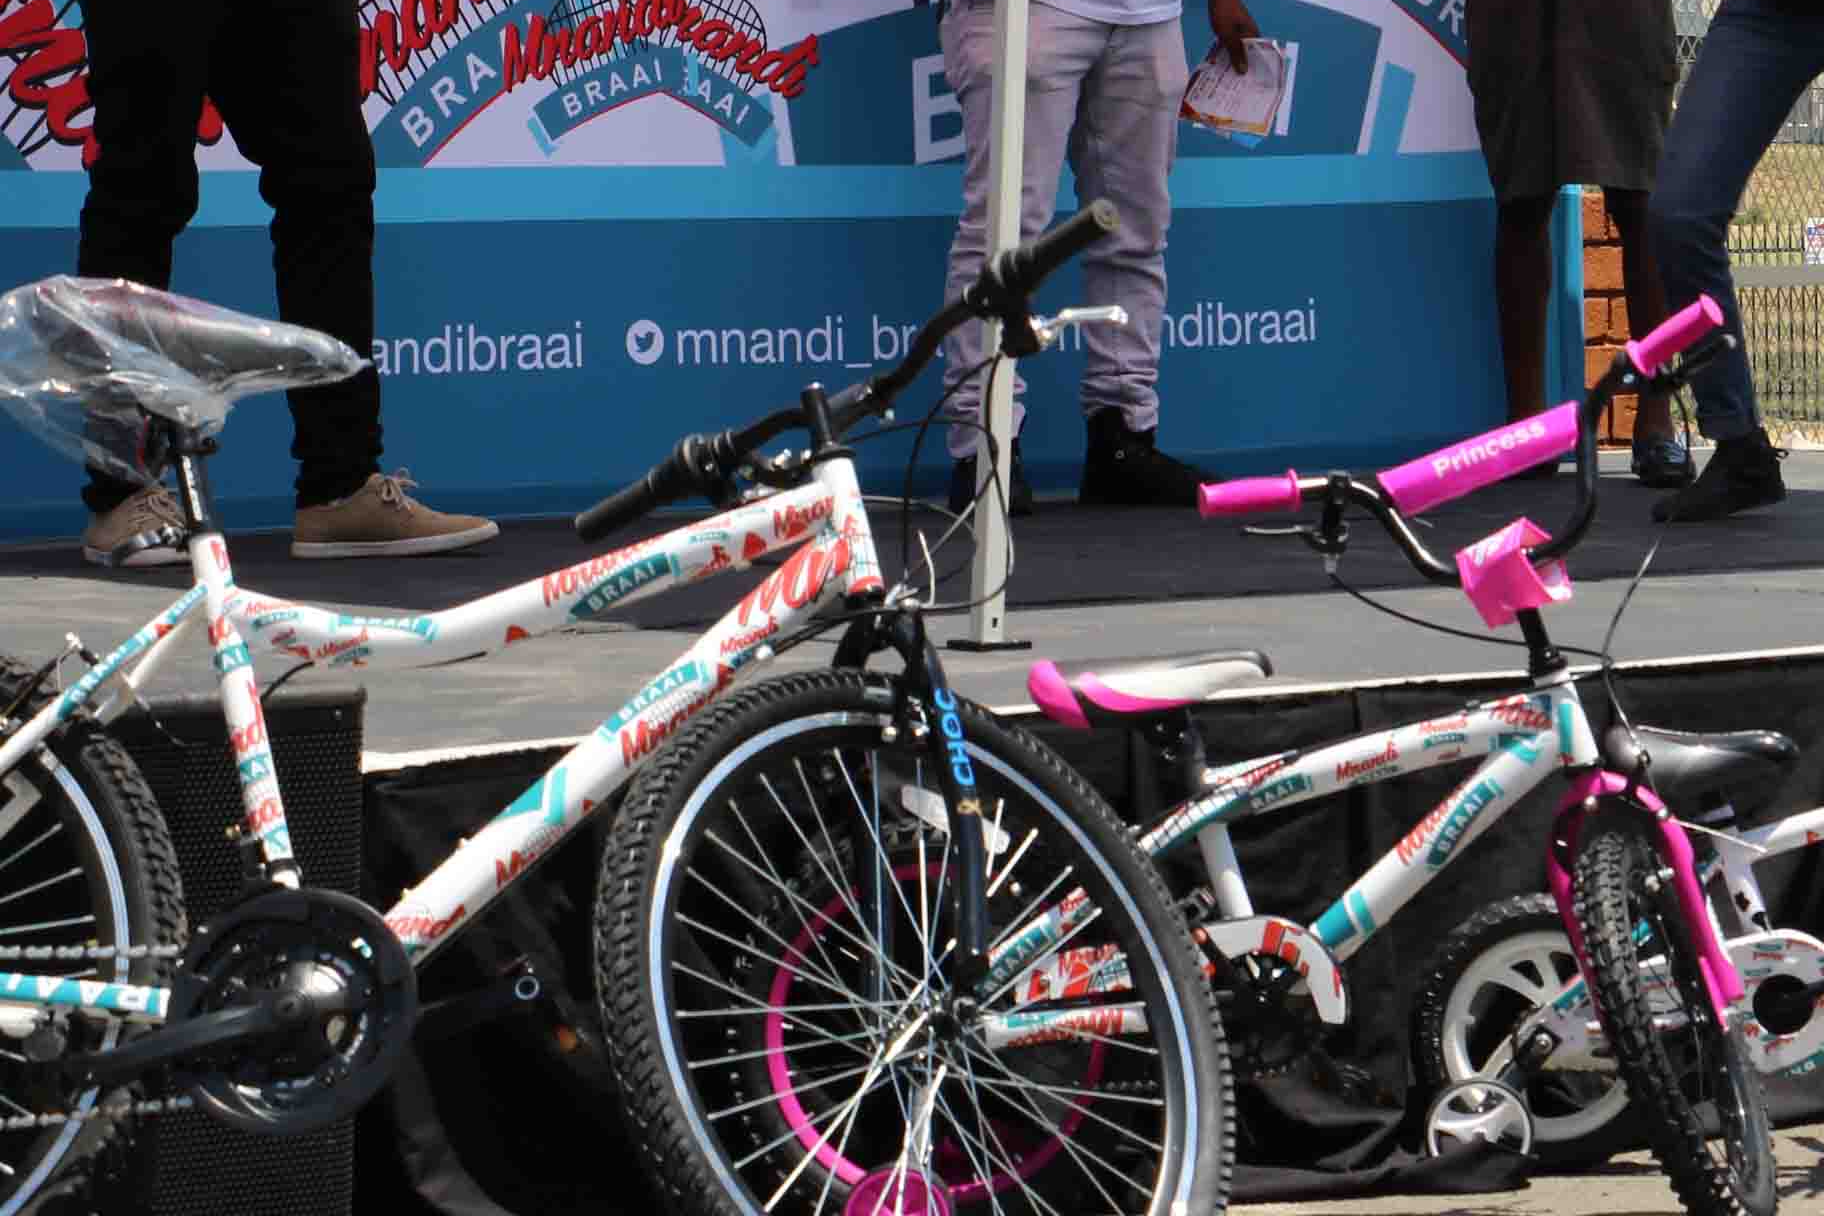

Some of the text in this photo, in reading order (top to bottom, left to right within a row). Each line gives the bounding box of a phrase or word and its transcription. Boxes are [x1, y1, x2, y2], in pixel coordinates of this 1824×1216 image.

[561, 56, 664, 118] BRAAI
[1431, 420, 1546, 479] Princess
[587, 560, 658, 613] BRAAI
[616, 668, 688, 722] BRAAI
